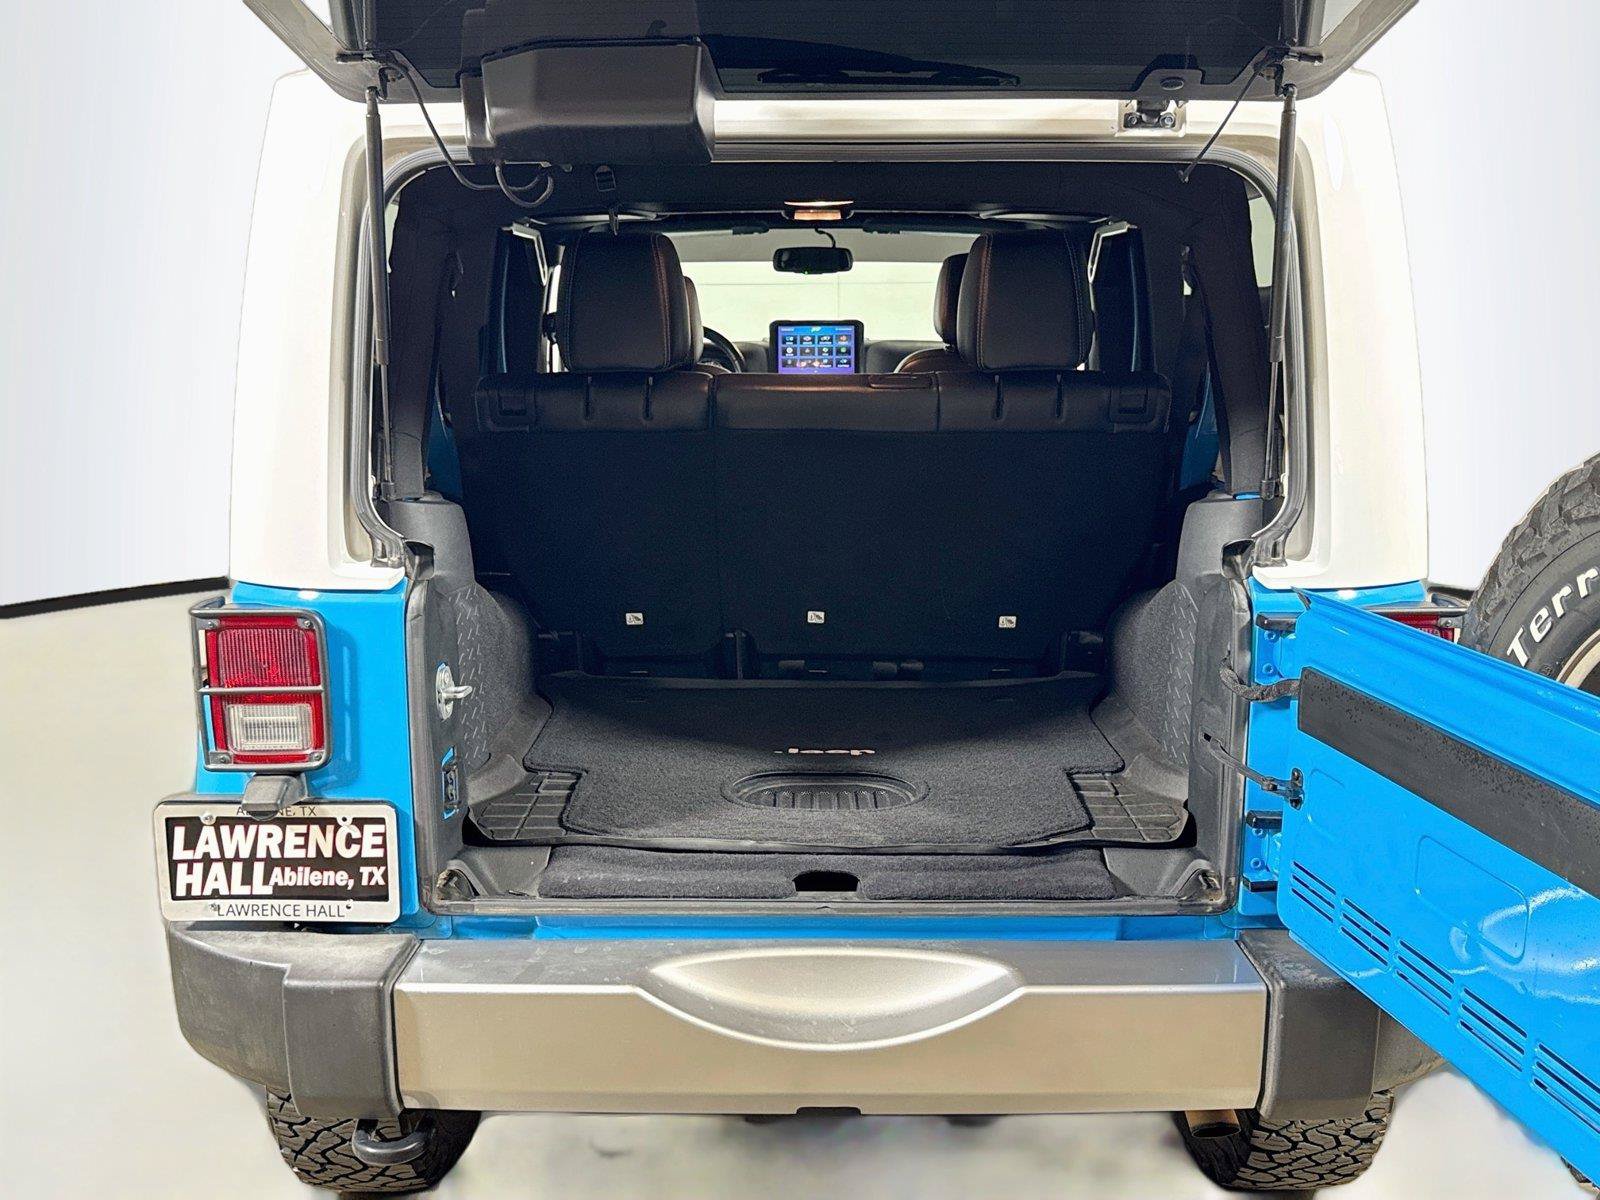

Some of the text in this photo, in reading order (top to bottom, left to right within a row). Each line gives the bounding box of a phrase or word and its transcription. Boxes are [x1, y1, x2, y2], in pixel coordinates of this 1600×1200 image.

[300, 806, 317, 817] TX
[172, 824, 386, 860] LAWRENCE
[175, 861, 273, 897] HALL
[269, 866, 386, 890] Abilene, TX
[217, 903, 345, 918] LAWRENCE HALL
